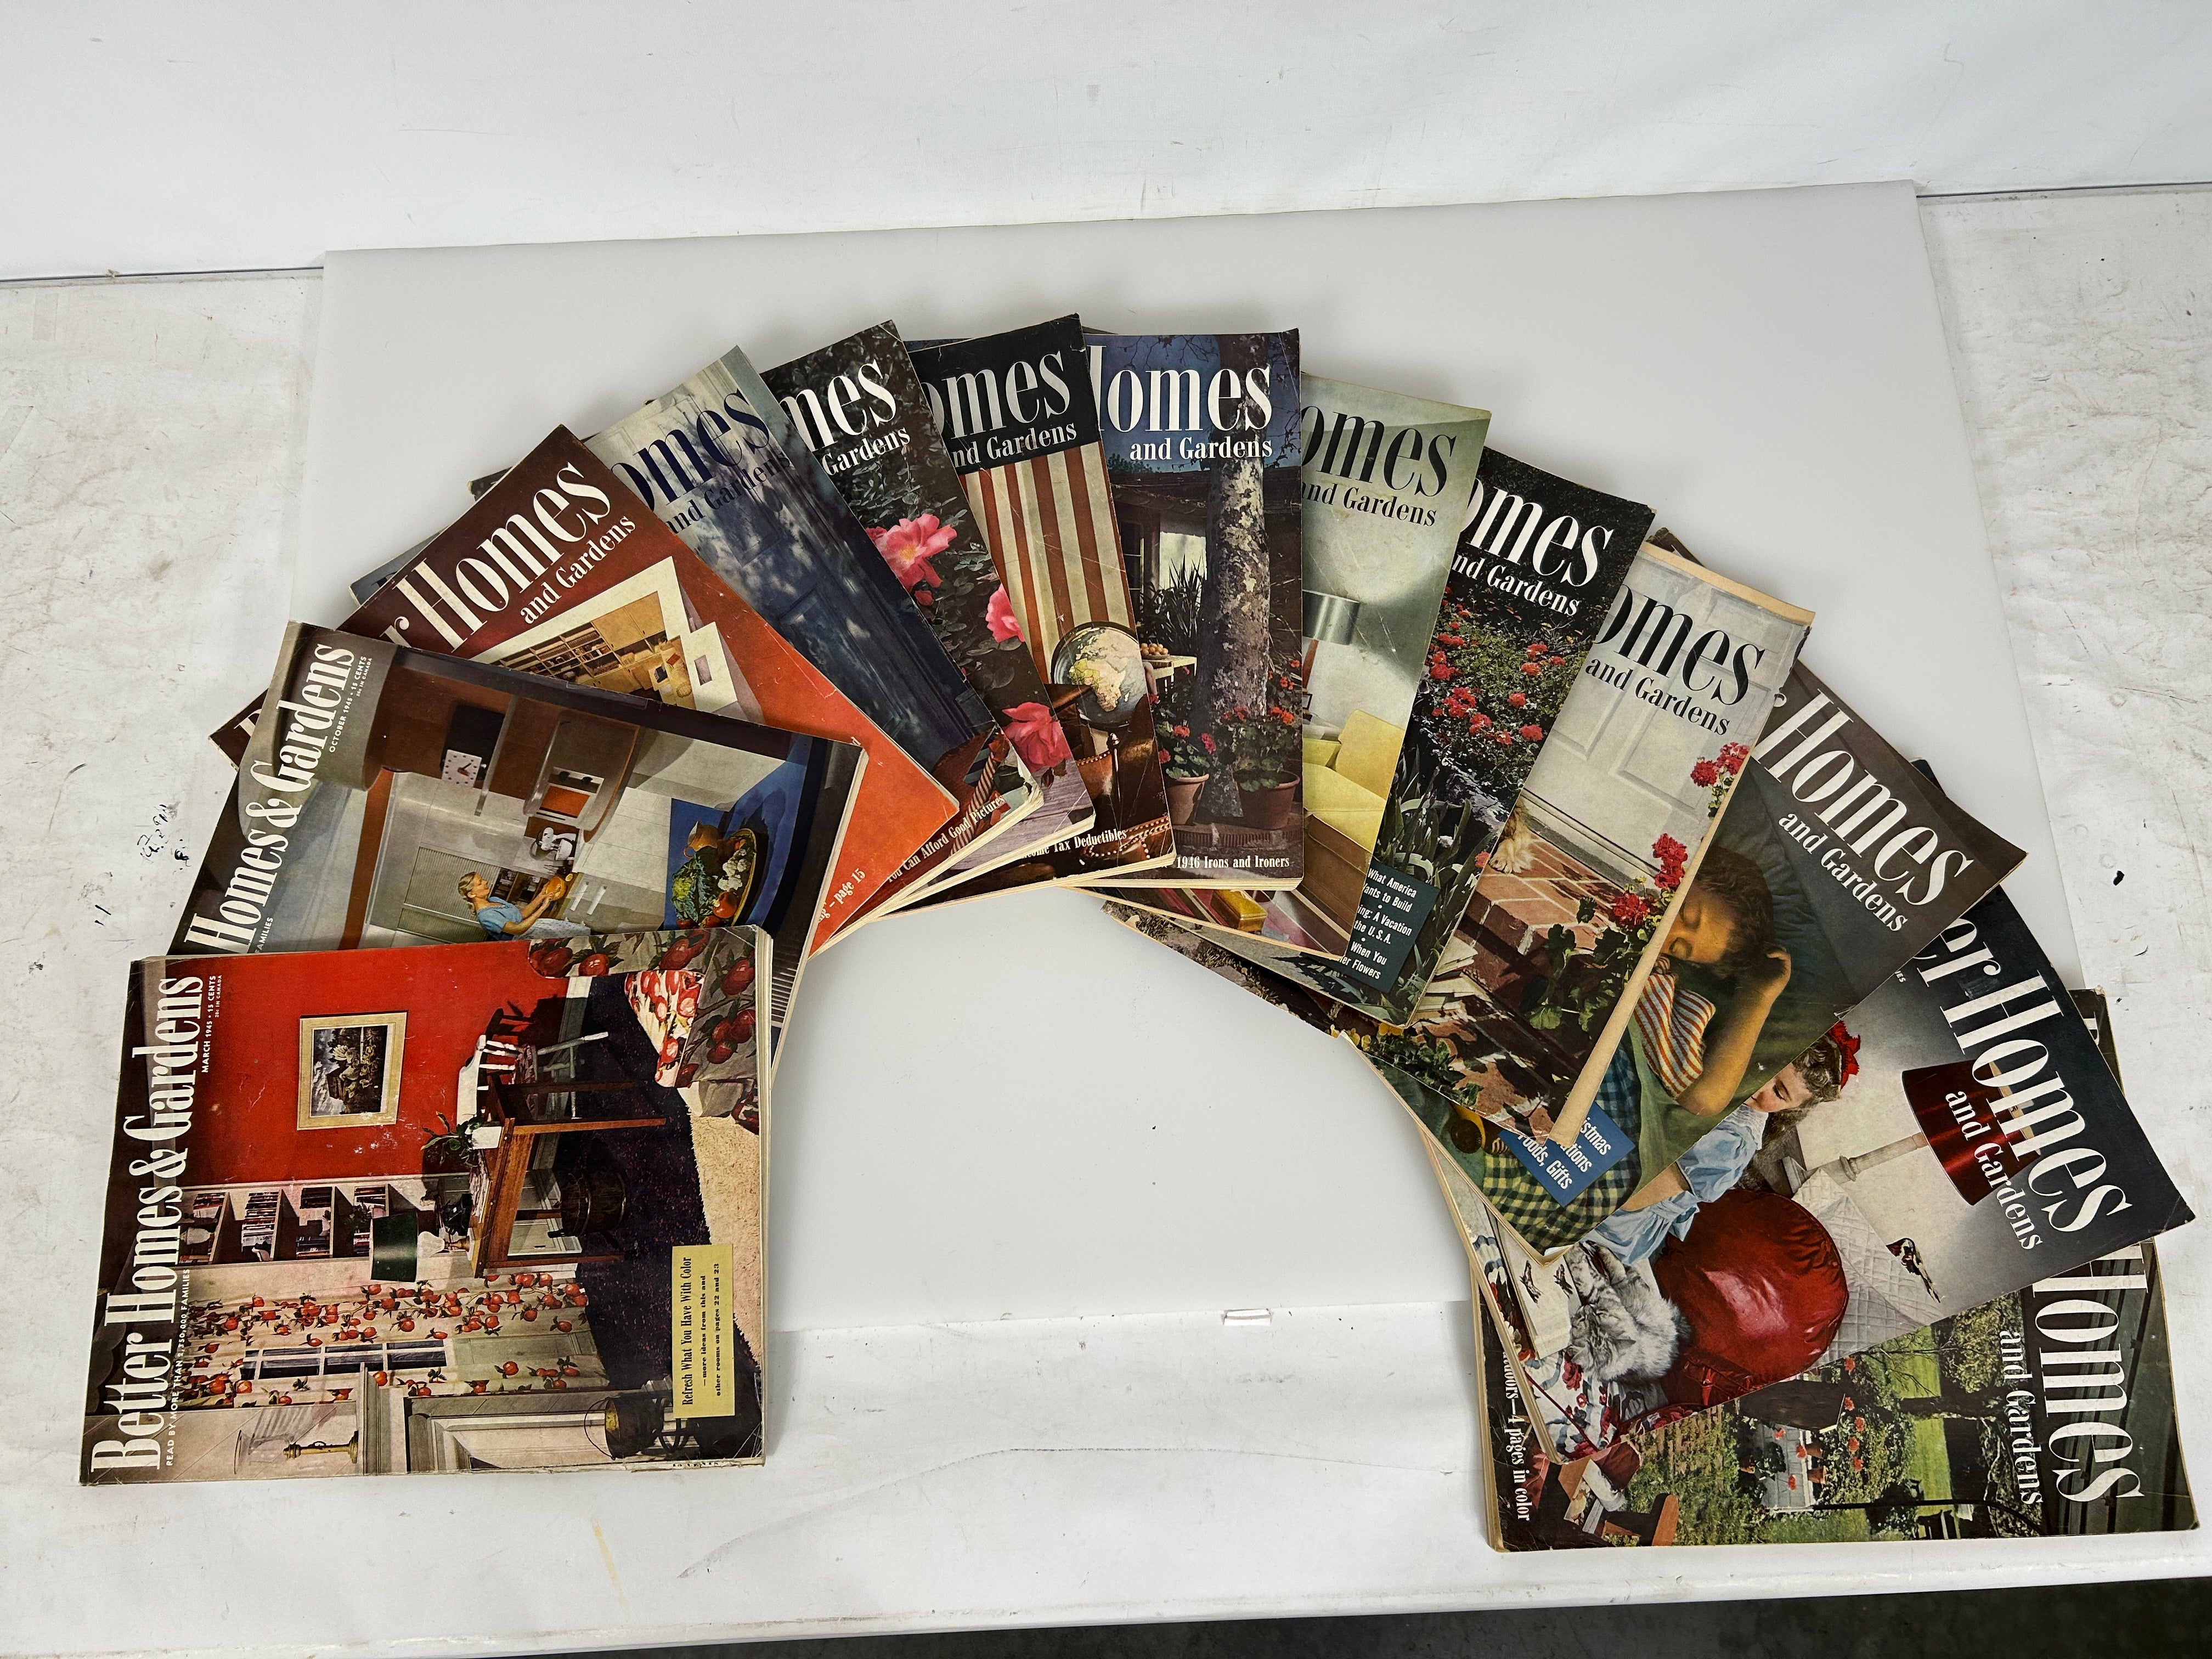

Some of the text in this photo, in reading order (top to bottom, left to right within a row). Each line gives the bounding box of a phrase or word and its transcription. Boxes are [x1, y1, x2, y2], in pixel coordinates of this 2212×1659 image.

[611, 388, 770, 512] omes
[821, 427, 911, 476] Gardens
[951, 422, 1077, 467] nd Gardens
[1130, 435, 1272, 460] and Gardens
[1301, 405, 1458, 497] omes
[704, 452, 790, 510] Gardens
[1344, 486, 1437, 527] Gardens
[392, 461, 611, 653] Homes
[521, 515, 636, 625] and Gardens
[1452, 553, 1581, 617] nd Gardens
[362, 658, 373, 680] CANADA
[329, 656, 366, 753] OCTOBER 1945 15 CENTS
[1585, 658, 1633, 691] and
[1635, 676, 1731, 736] Gardens
[184, 643, 356, 954] Homes & Gardens
[1751, 689, 1974, 906] Homes
[903, 855, 922, 870] Can
[921, 832, 950, 859] Afford
[948, 817, 972, 839] Good
[969, 795, 1006, 823] Pictures
[1074, 828, 1127, 849] Deductibles
[1176, 855, 1290, 868] 1946 Irons and Ironers
[1779, 812, 1908, 932] and Gardens
[833, 867, 866, 905] page 15
[1367, 868, 1418, 899] What America
[1382, 892, 1391, 904] to
[1392, 896, 1413, 913] Build
[255, 917, 274, 953] FAMILIES
[1353, 919, 1367, 933] the
[1372, 911, 1381, 922] A
[1380, 914, 1413, 936] Vacation
[1350, 941, 1388, 966] When You
[1351, 959, 1381, 980] Flowers
[208, 975, 216, 1001] CENTS
[207, 1004, 214, 1012] 15
[201, 1041, 211, 1073] MARCH
[1939, 969, 2133, 1233] Homes
[1546, 1160, 1573, 1190] Gifts
[1945, 1090, 2044, 1250] and Gardens
[90, 976, 204, 1473] Better Homes & Gardens
[713, 1263, 719, 1274] 23
[180, 1269, 190, 1310] FAMILIES
[714, 1295, 720, 1306] 22
[680, 1257, 693, 1406] Refresh What You Have With Color
[715, 1334, 720, 1344] on
[173, 1360, 183, 1388] THAN
[2032, 1243, 2148, 1503] Homes
[170, 1391, 179, 1420] MORE
[1999, 1330, 2044, 1505] and Gardens
[168, 1423, 176, 1436] BY
[1504, 1428, 1526, 1465] pages
[166, 1440, 175, 1466] READ
[1513, 1470, 1530, 1483] in
[1515, 1488, 1533, 1521] color
